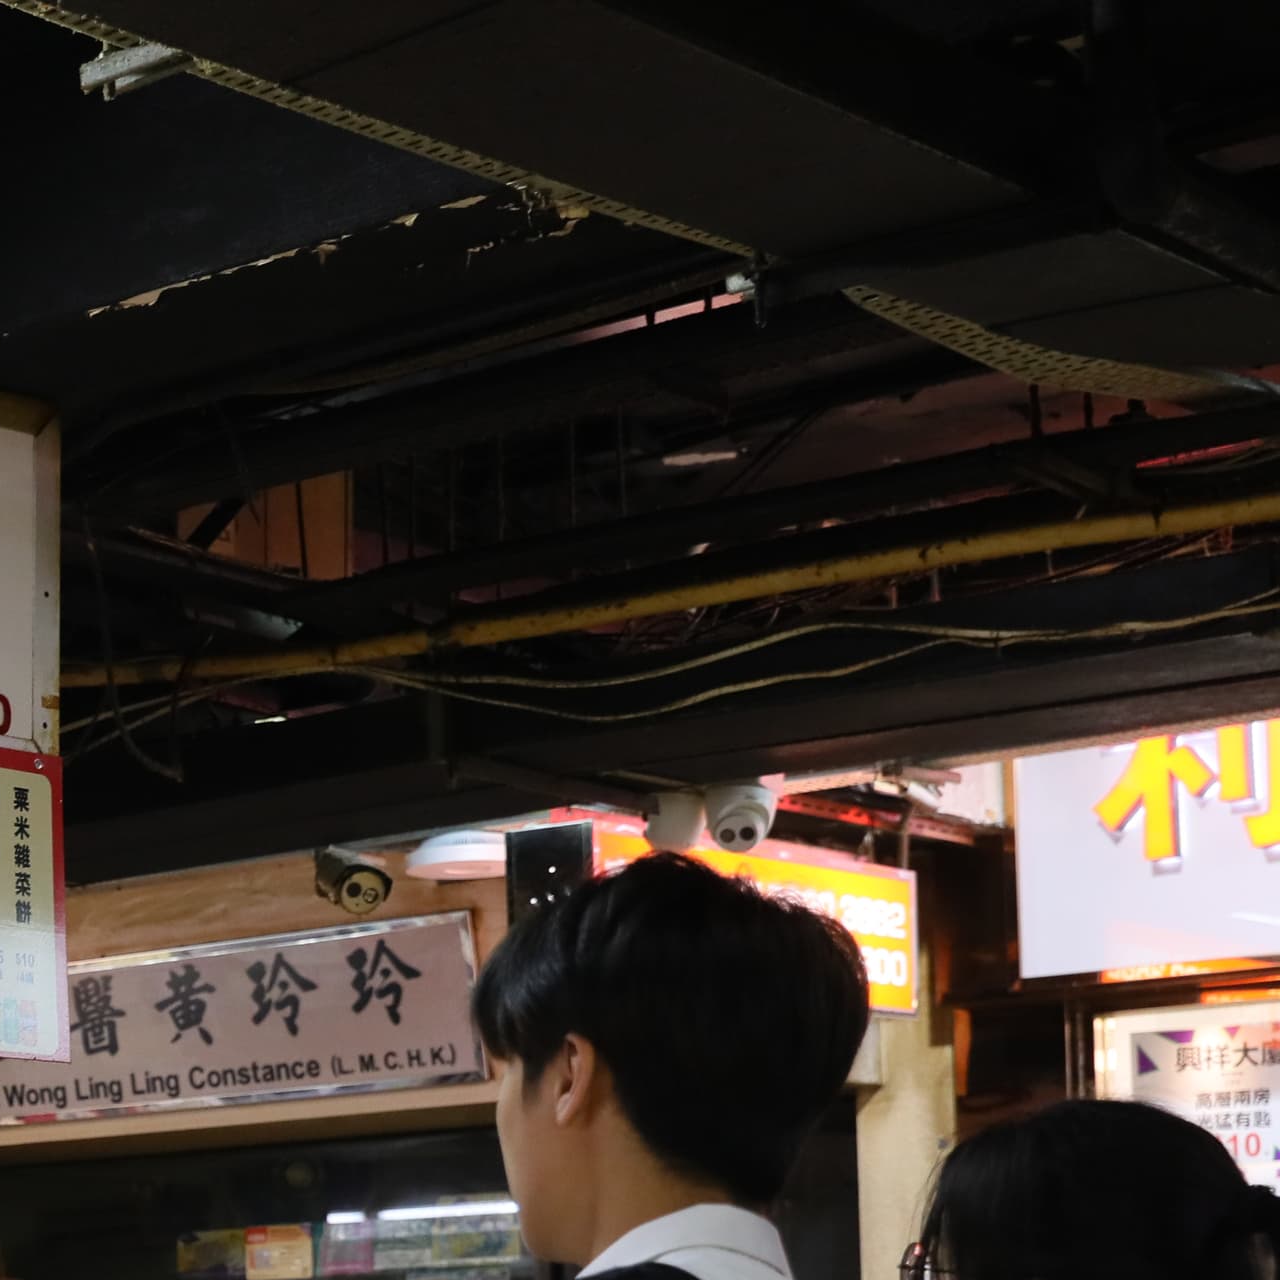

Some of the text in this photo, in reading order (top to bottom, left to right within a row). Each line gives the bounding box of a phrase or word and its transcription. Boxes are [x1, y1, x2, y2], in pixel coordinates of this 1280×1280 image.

[3, 1082, 67, 1109] Wong
[75, 1077, 123, 1104] Ling
[131, 1070, 181, 1098] Ling
[188, 1057, 320, 1090] Constance
